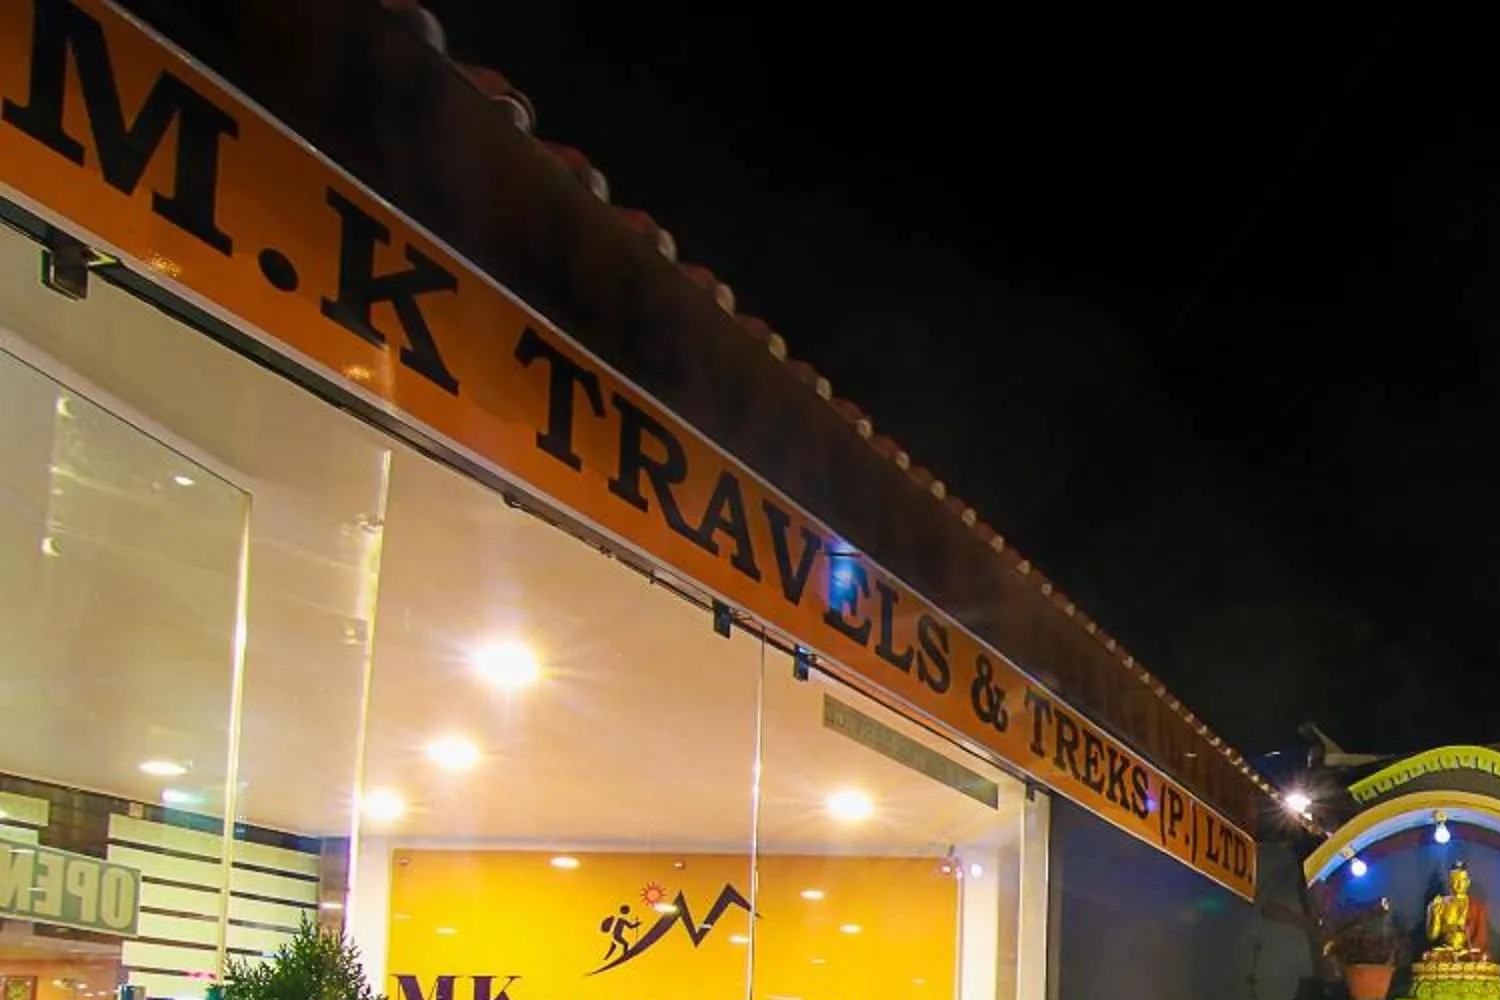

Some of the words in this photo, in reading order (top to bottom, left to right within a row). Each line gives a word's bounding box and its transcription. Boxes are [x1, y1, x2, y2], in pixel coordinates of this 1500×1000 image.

[2, 0, 459, 396] M.K
[514, 325, 950, 694] TRAVELS
[972, 653, 1008, 732] &
[1024, 685, 1150, 820] TREKS
[1206, 815, 1253, 884] LTD.
